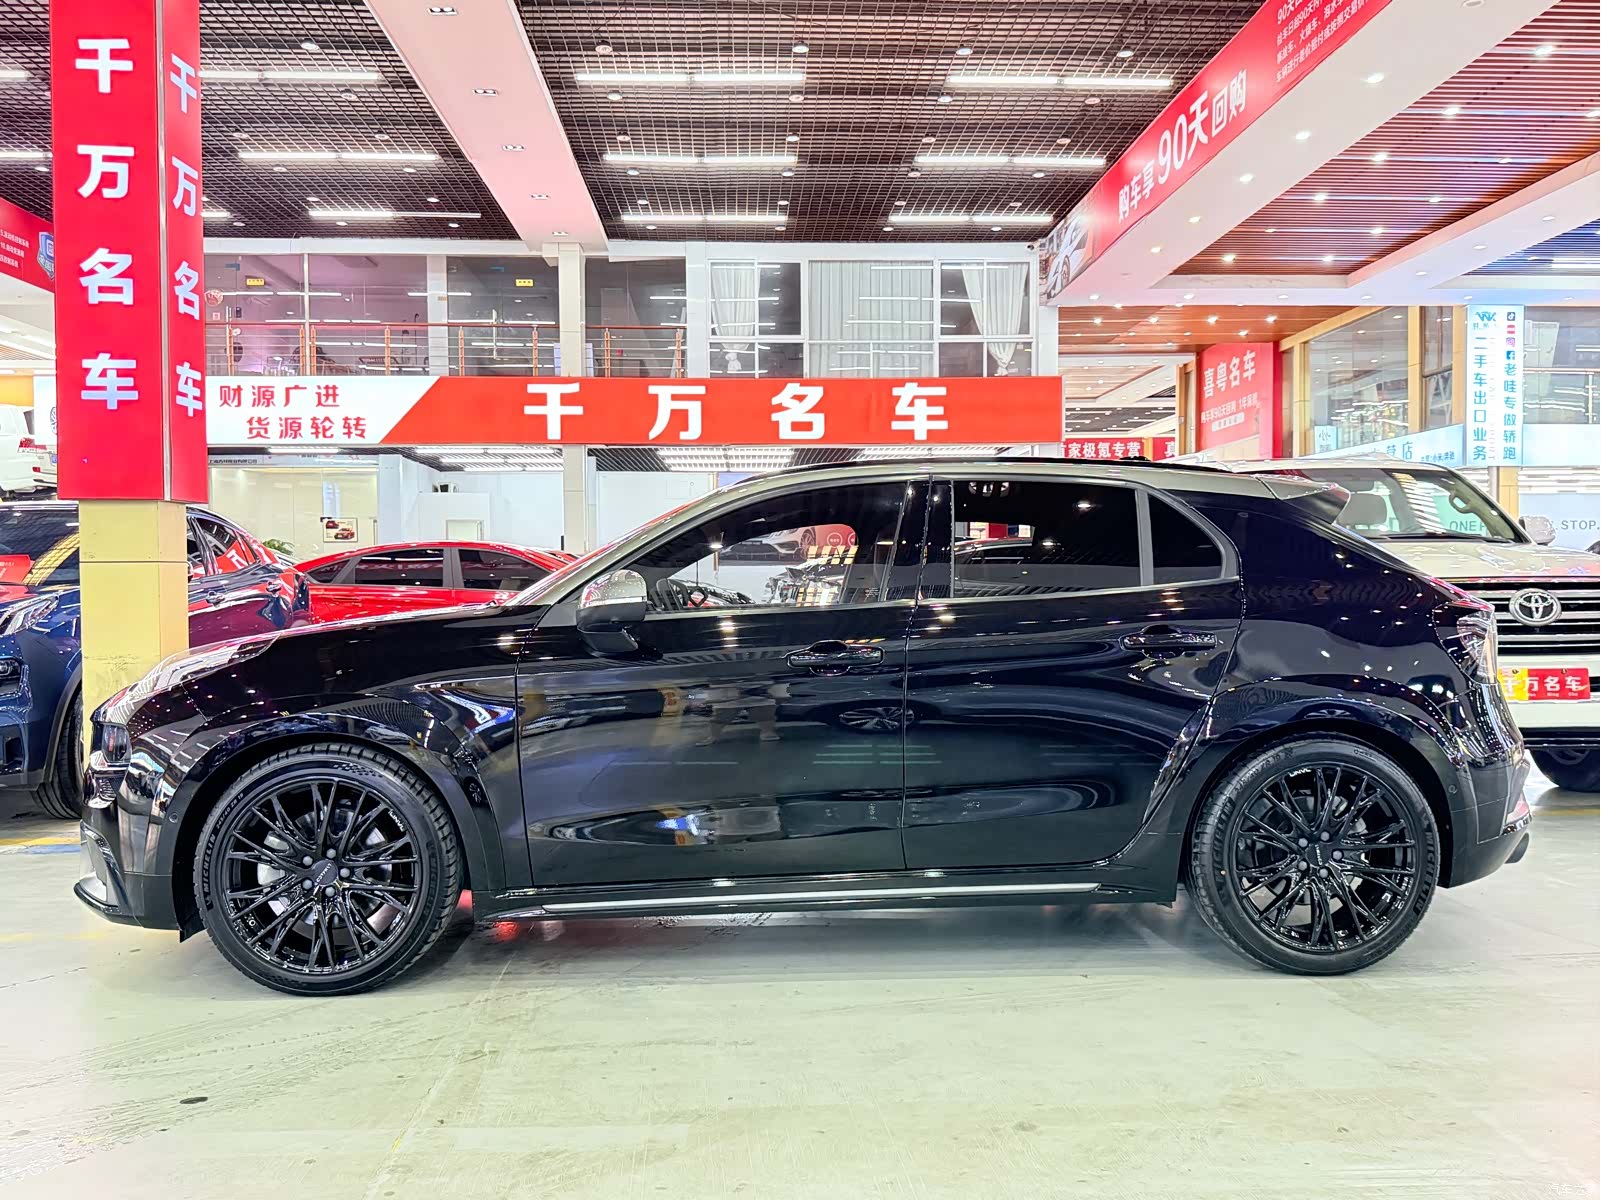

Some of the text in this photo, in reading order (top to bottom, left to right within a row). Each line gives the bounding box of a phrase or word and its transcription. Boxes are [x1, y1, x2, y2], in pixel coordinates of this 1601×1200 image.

[1118, 69, 1247, 224] 购车享90天回购
[75, 38, 139, 411] 千万名车
[170, 53, 203, 417] 千万名车
[219, 384, 341, 408] 财源广进
[1204, 350, 1256, 399] 喜粤名车
[1473, 336, 1488, 461] 二手车出口业务
[246, 416, 367, 440] 货源轮转
[524, 382, 950, 441] 千万名车
[1450, 520, 1477, 531] ONE
[1503, 676, 1582, 691] 千万名车
[202, 833, 216, 894] MICHELIN
